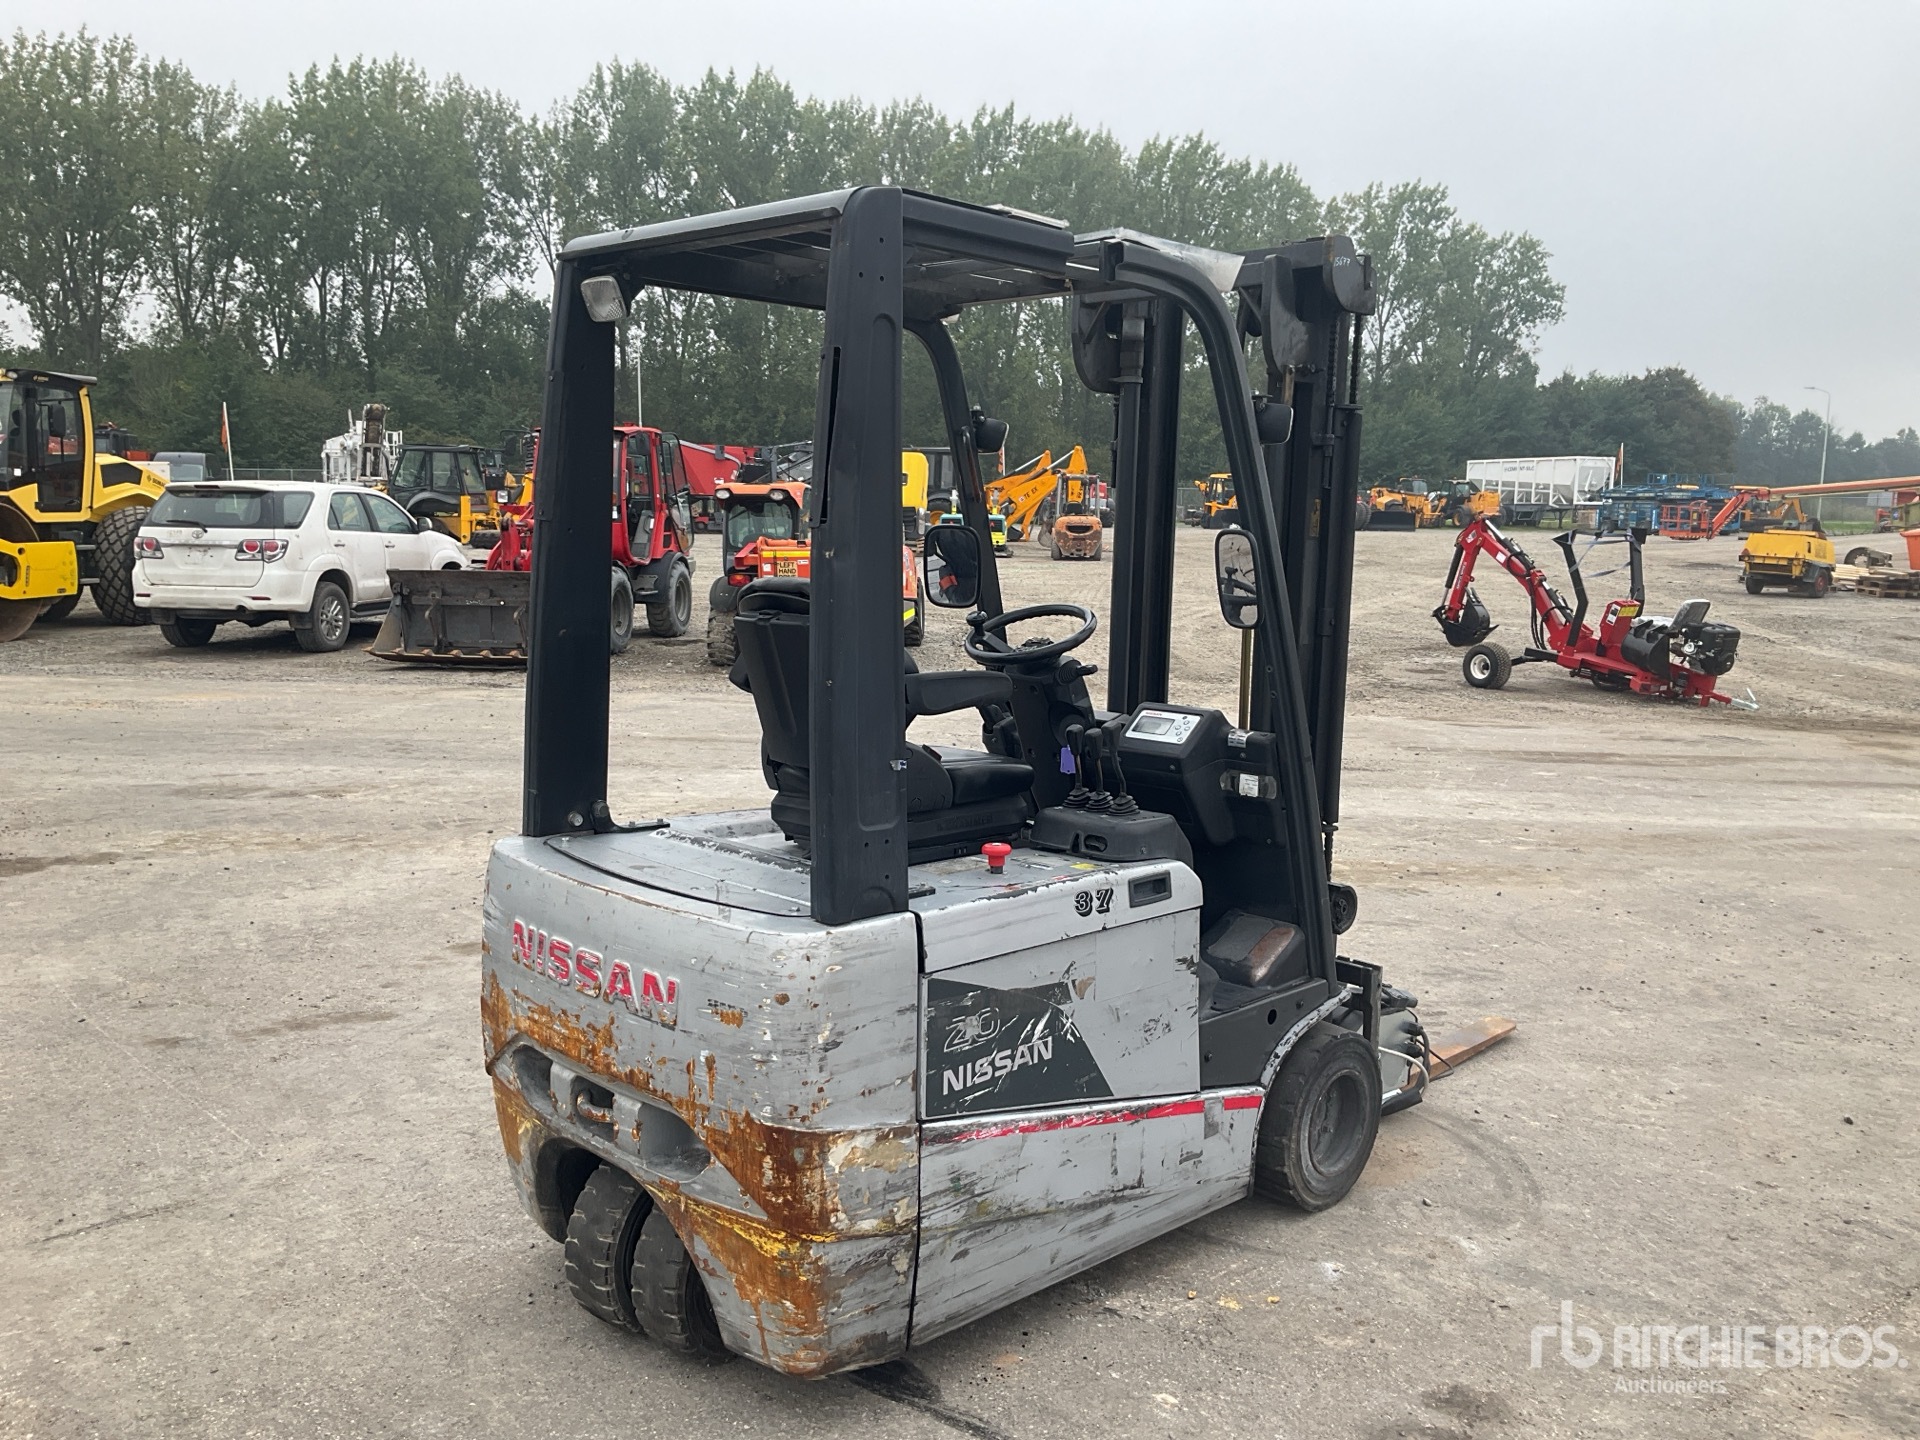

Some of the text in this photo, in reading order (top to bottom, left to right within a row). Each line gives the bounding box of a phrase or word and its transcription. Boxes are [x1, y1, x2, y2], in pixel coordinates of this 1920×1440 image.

[1074, 887, 1114, 917] 37
[512, 918, 680, 1027] NISSAN
[943, 1036, 1053, 1096] NISSAN
